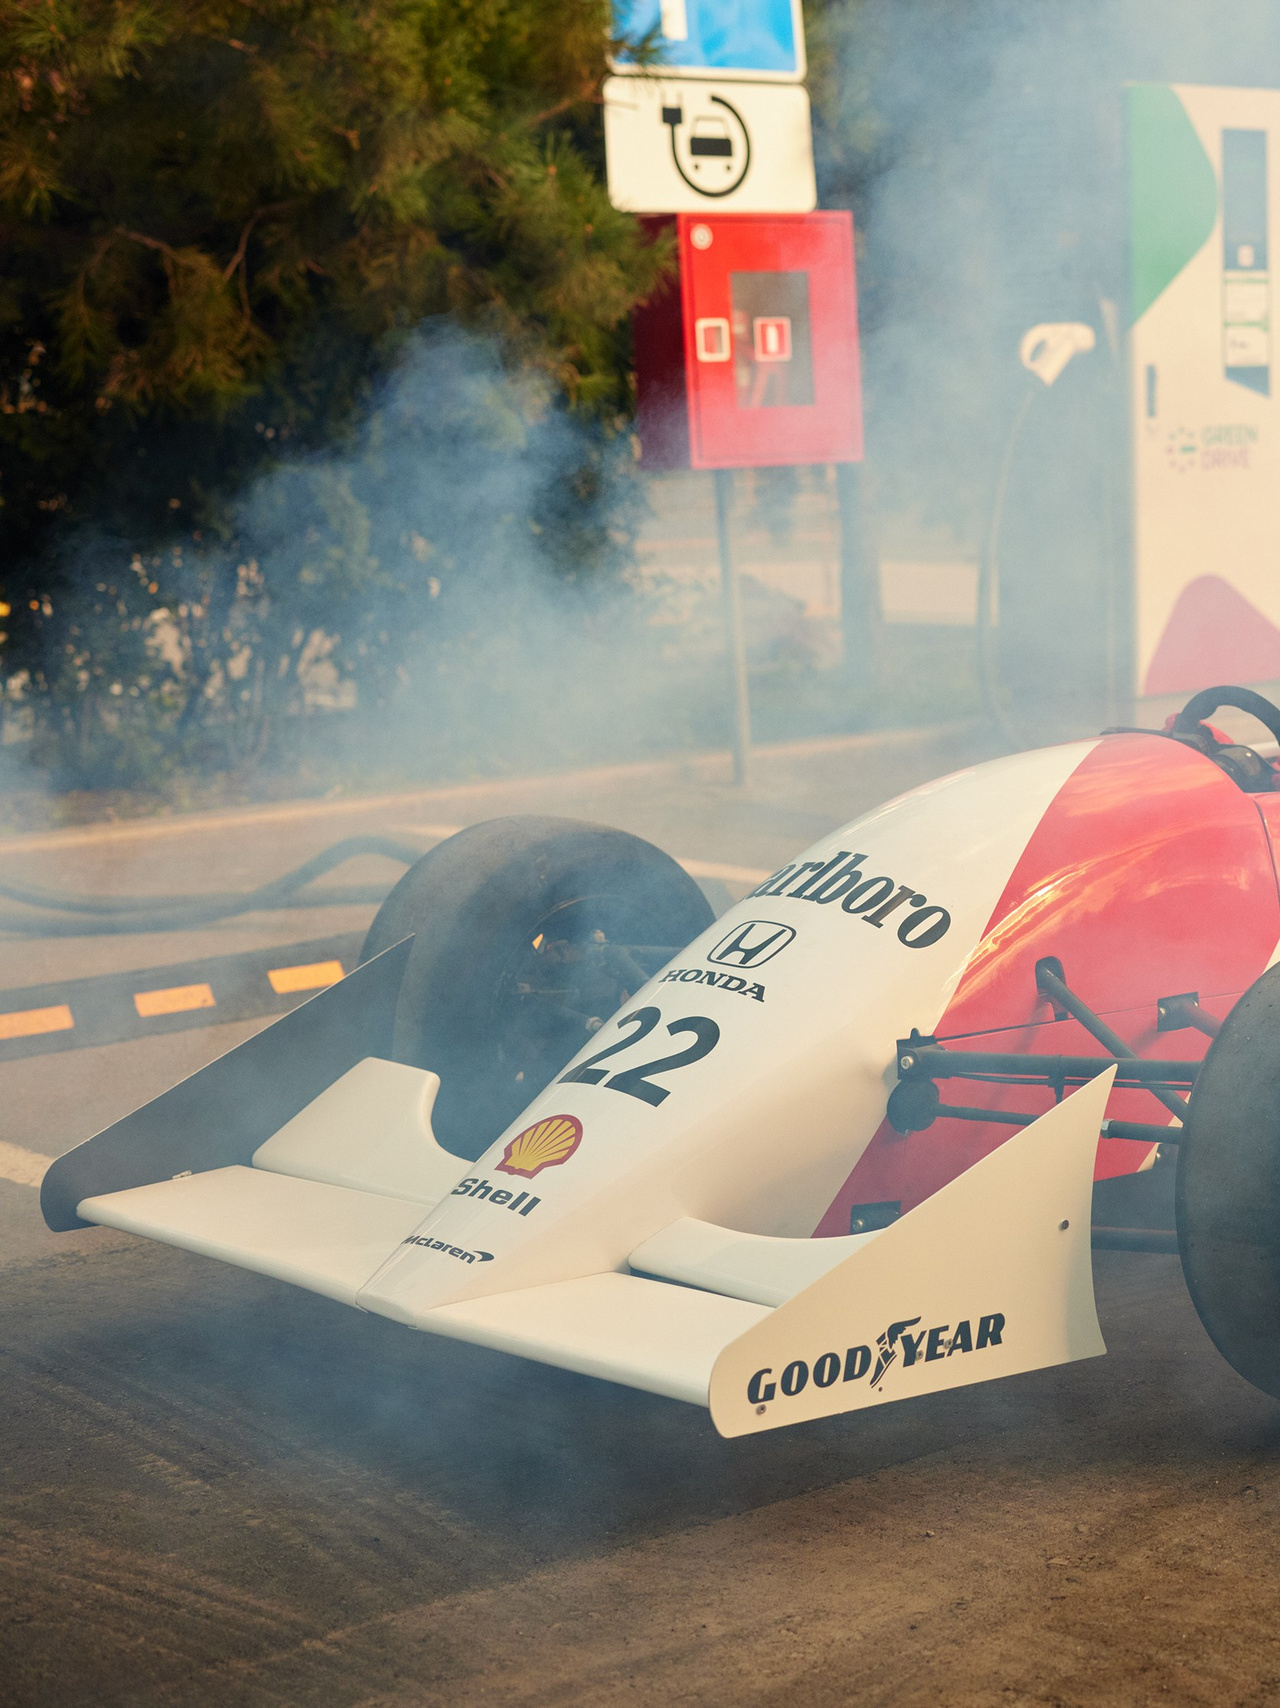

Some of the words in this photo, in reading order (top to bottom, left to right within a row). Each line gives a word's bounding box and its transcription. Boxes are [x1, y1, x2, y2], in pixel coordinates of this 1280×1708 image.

[745, 850, 952, 949] arlboro
[658, 969, 766, 1003] HONDA
[556, 1006, 721, 1108] 22
[450, 1177, 542, 1217] Shell
[401, 1234, 477, 1265] McLaren
